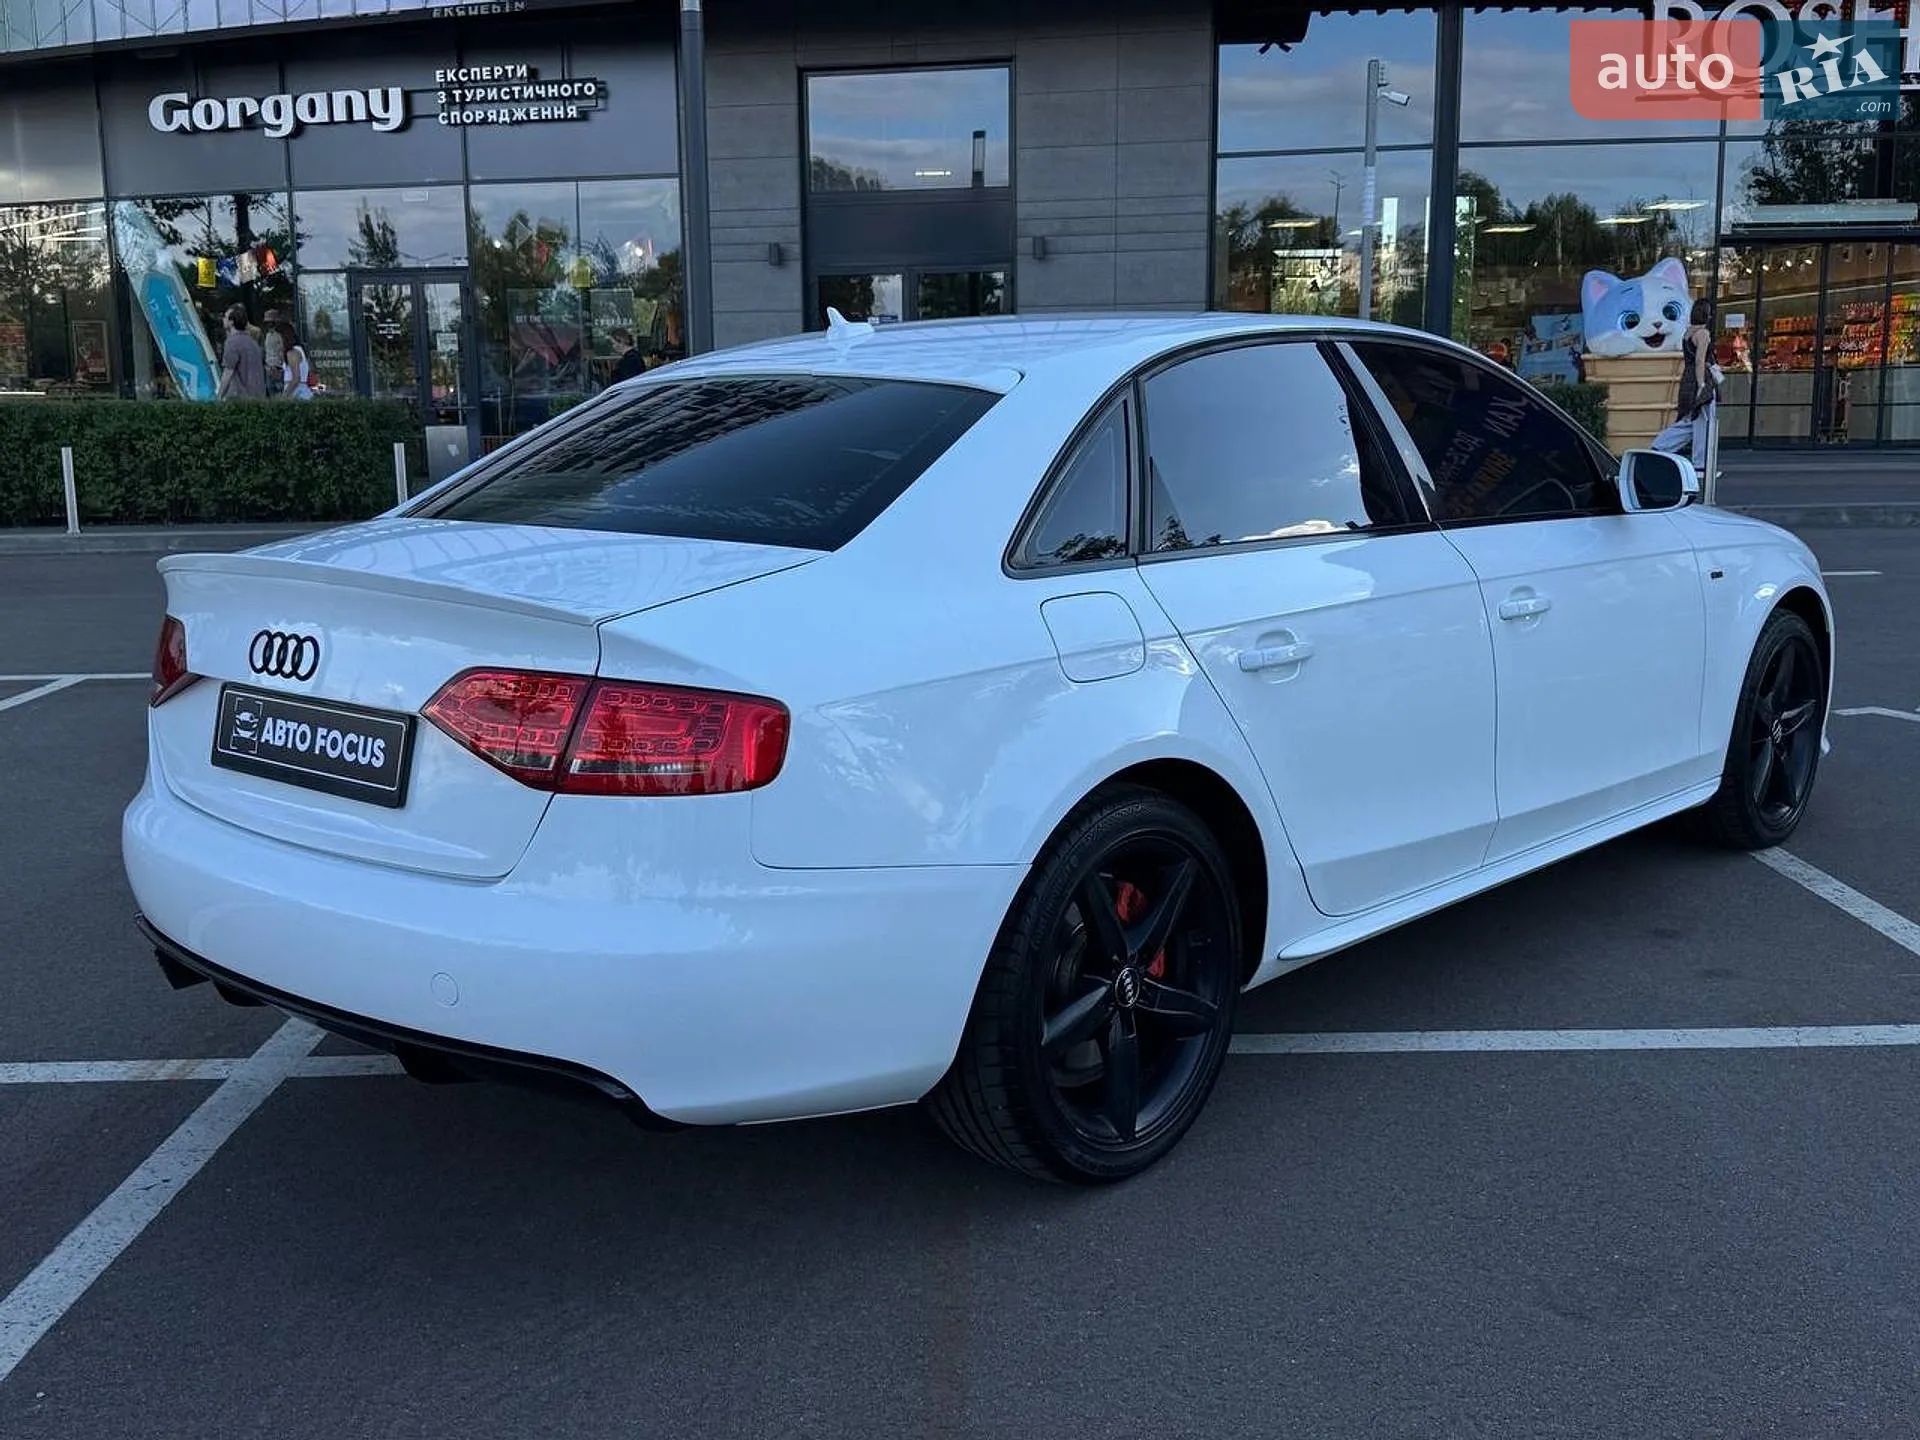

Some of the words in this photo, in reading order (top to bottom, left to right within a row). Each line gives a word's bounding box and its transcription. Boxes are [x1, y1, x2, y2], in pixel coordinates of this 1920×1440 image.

[435, 63, 528, 82] ЕКСПЕРТИ
[452, 82, 596, 103] ТУРИСТИЧНОГО
[148, 87, 402, 138] Gorgany
[438, 105, 578, 125] СПОРЯДЖЕННЯ
[261, 716, 312, 752] АВТО
[314, 726, 386, 768] FOCUS
